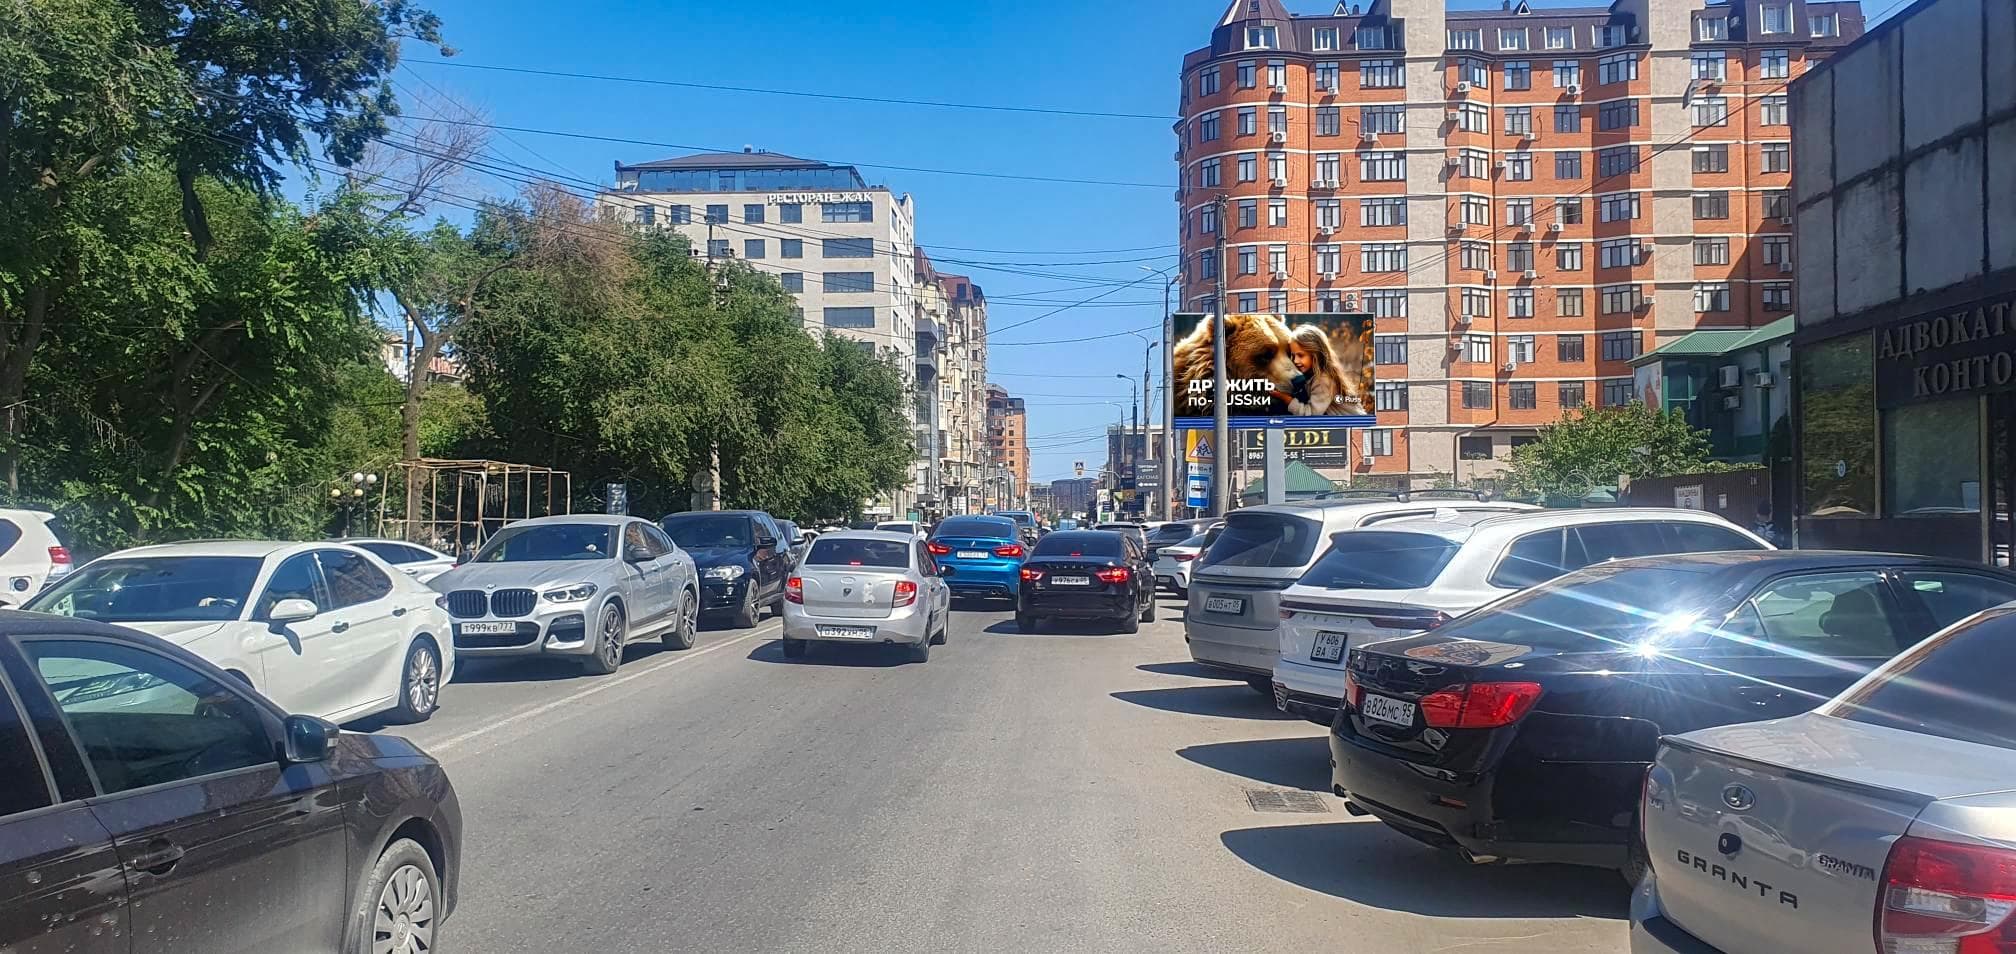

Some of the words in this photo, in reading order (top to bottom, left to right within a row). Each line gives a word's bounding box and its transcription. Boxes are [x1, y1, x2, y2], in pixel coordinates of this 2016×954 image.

[767, 193, 832, 203] РЕСТОРАН
[840, 192, 872, 202] ЖАК
[1913, 349, 2016, 398] КОНТО
[1187, 378, 1275, 394] ДРЖИТЬ
[1188, 394, 1271, 406] по-USSки
[1256, 430, 1330, 446] SLDI
[1326, 634, 1340, 646] 606
[1818, 854, 1876, 882] GRANTA
[1677, 850, 1799, 910] GRANTA
